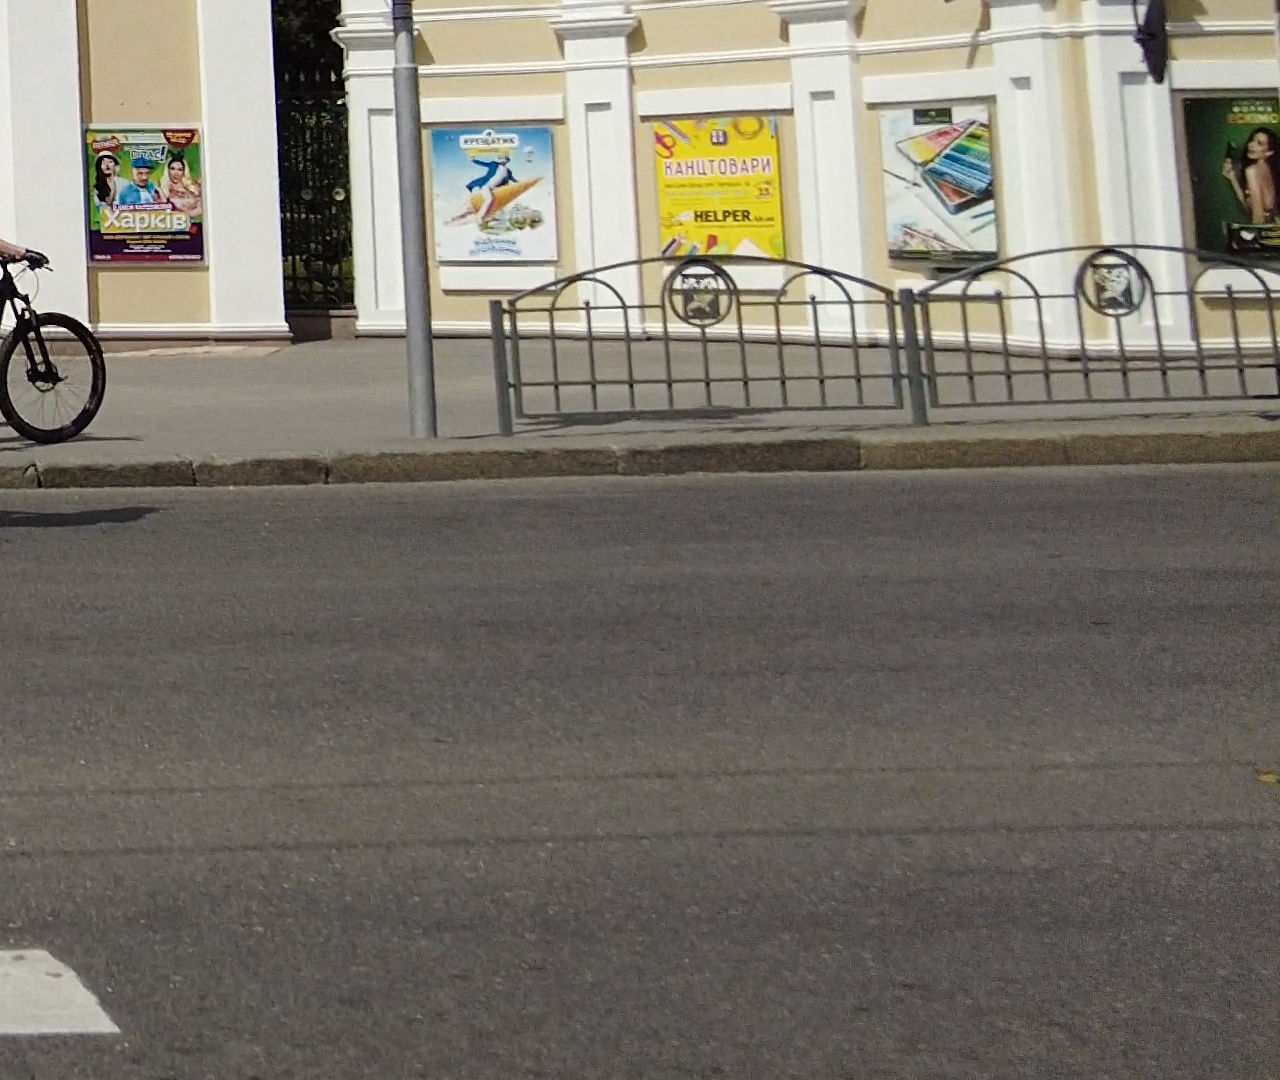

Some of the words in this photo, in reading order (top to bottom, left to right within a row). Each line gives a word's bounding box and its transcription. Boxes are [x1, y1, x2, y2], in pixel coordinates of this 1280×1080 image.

[663, 157, 772, 177] КАНЦТОВАРИ
[103, 210, 187, 232] Харків
[693, 209, 752, 222] HELPER
